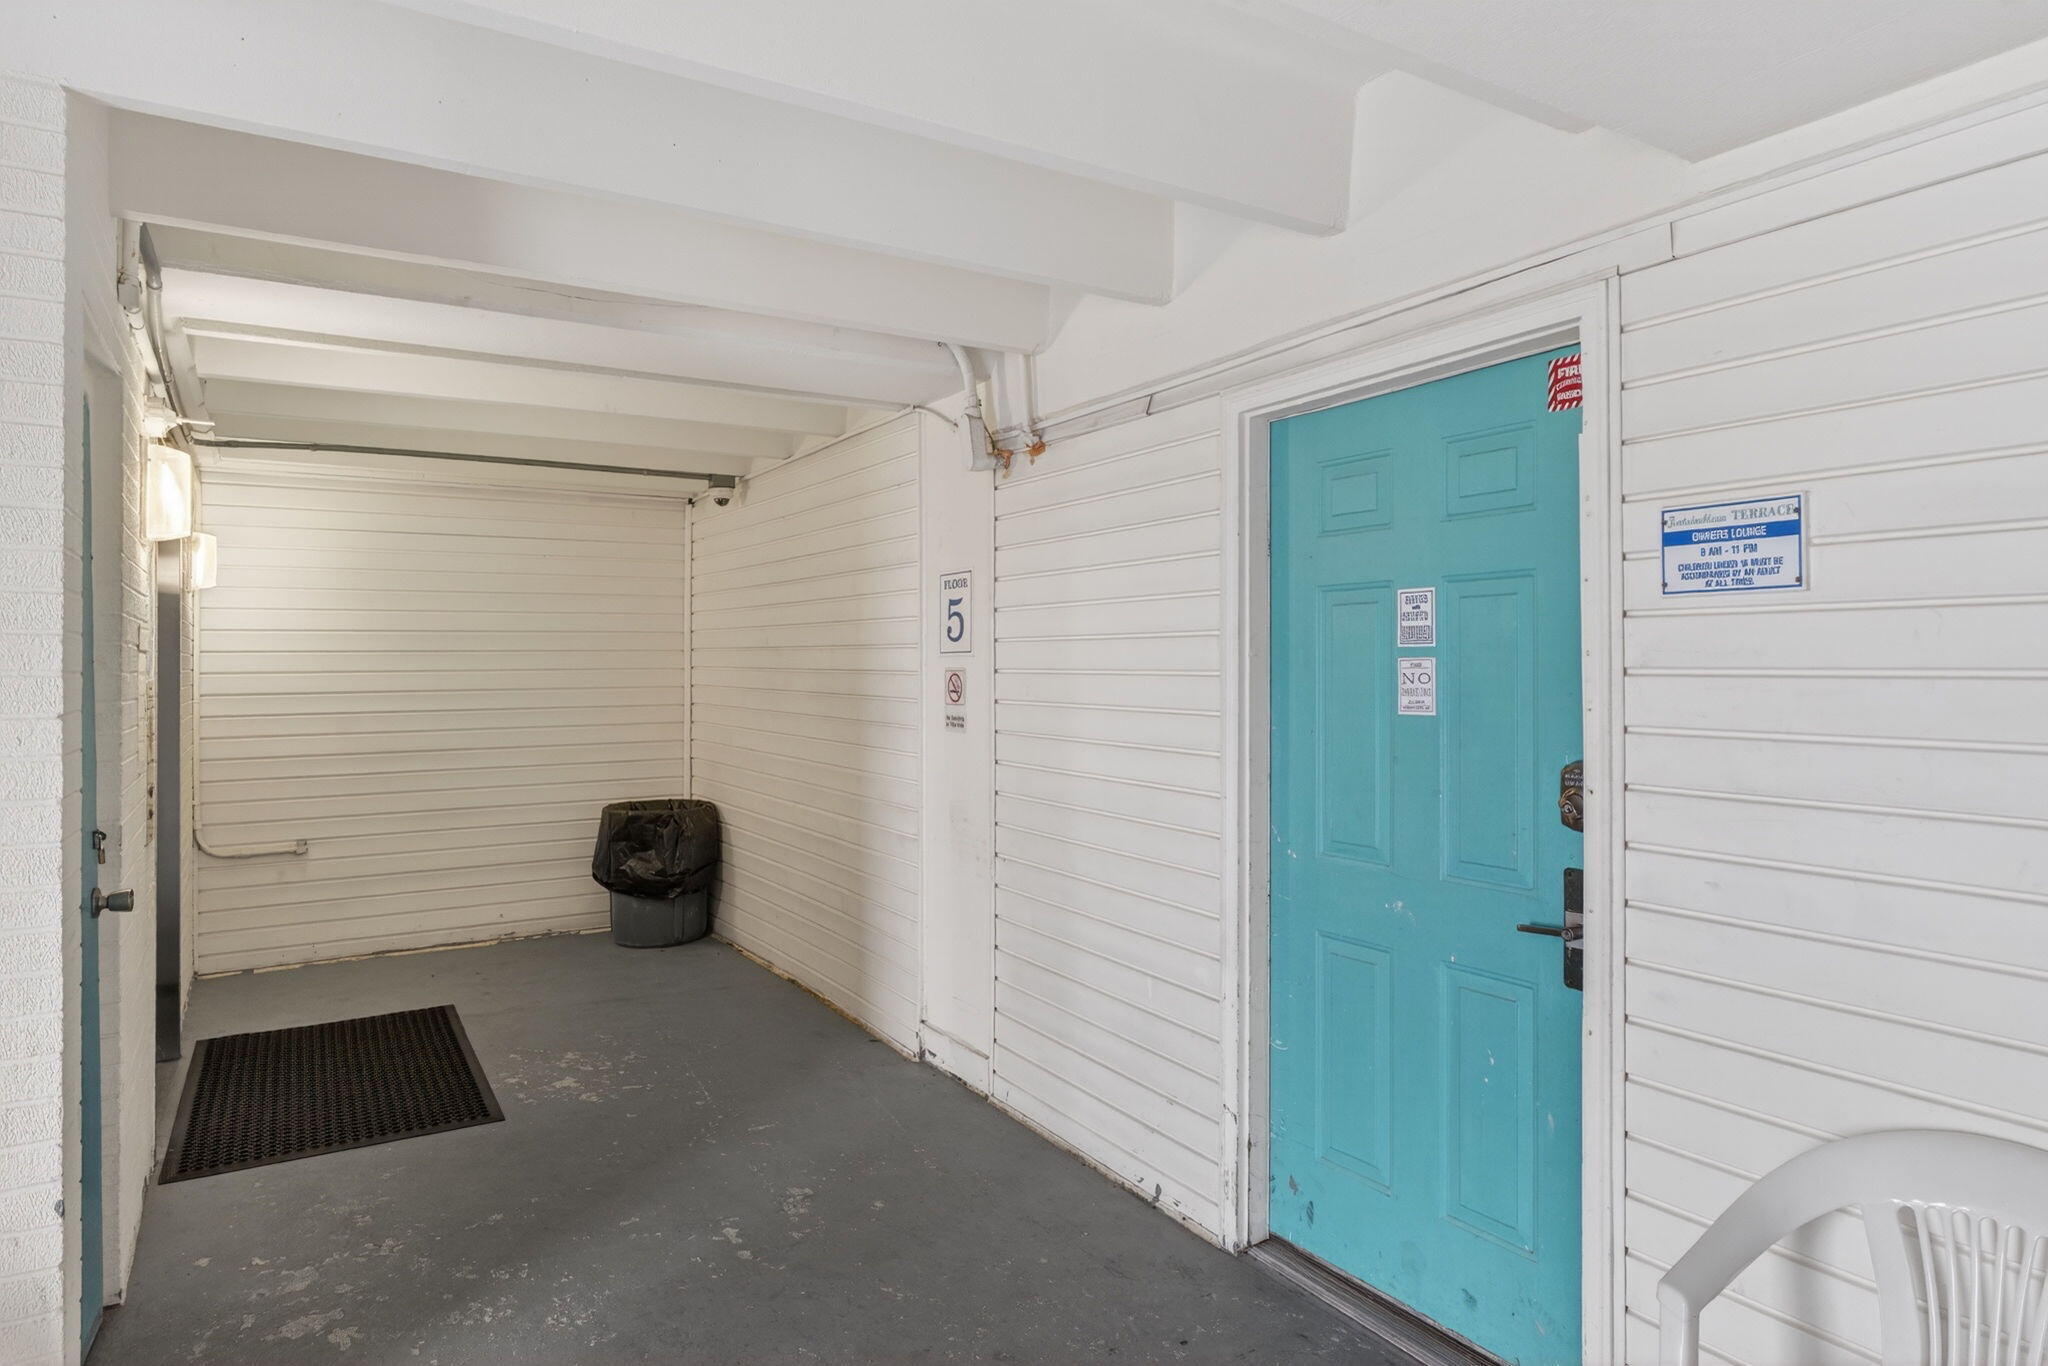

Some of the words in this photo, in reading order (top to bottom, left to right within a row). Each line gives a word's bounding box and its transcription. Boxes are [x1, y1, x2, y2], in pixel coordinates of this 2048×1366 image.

[1731, 503, 1794, 520] TERRACE
[1692, 530, 1729, 542] OWNERS
[1731, 525, 1767, 539] LOUNGE
[1708, 545, 1722, 556] AM
[1731, 545, 1740, 555] 11
[1743, 543, 1758, 553] PM
[944, 578, 968, 590] FLOOR
[947, 597, 965, 643] 5
[1402, 672, 1431, 685] NO
